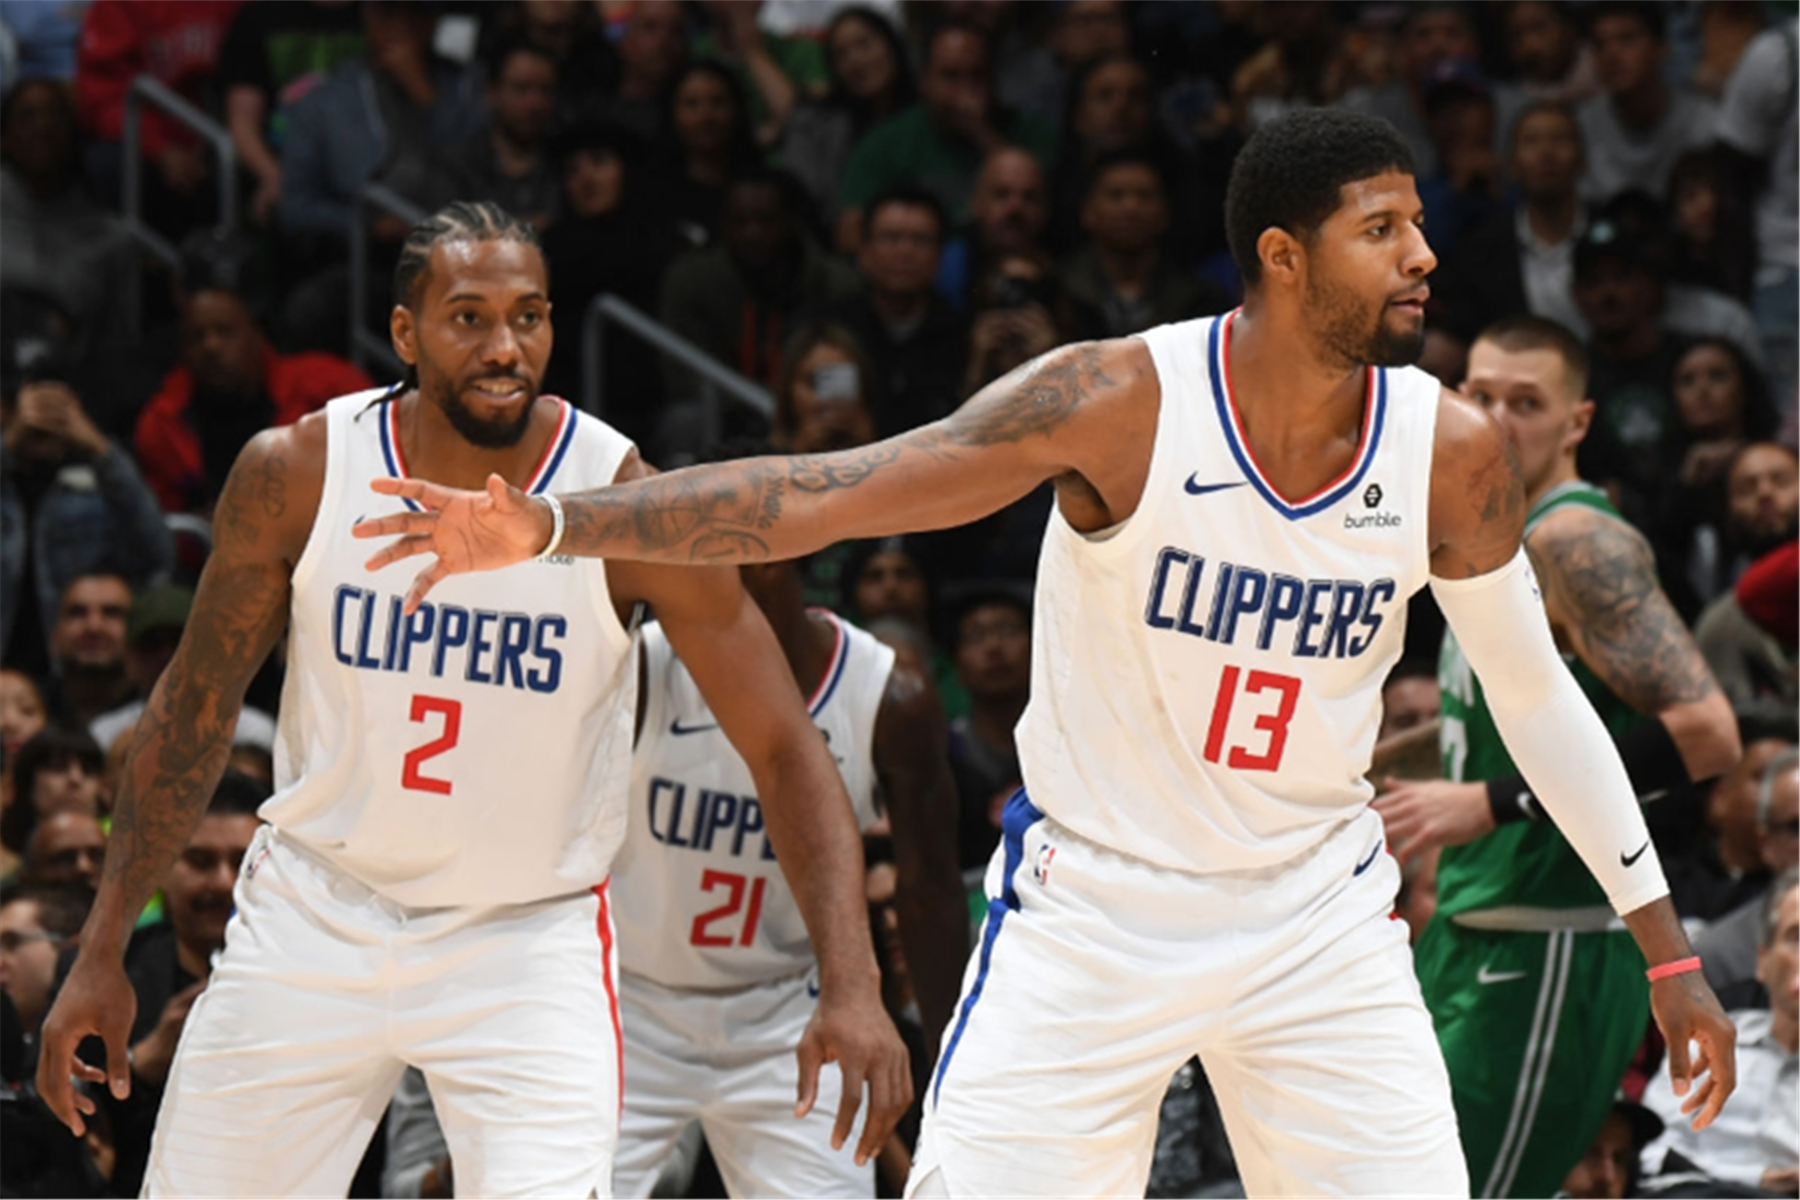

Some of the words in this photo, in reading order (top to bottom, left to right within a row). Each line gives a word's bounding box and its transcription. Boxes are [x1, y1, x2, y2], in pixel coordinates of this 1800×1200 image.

[1343, 511, 1402, 529] bumble
[332, 583, 568, 694] CLIPPERS
[1145, 546, 1395, 659] CLIPPERS
[401, 693, 462, 796] 2
[1203, 664, 1302, 772] 13
[647, 776, 777, 861] CLIPP
[690, 867, 766, 948] 21
